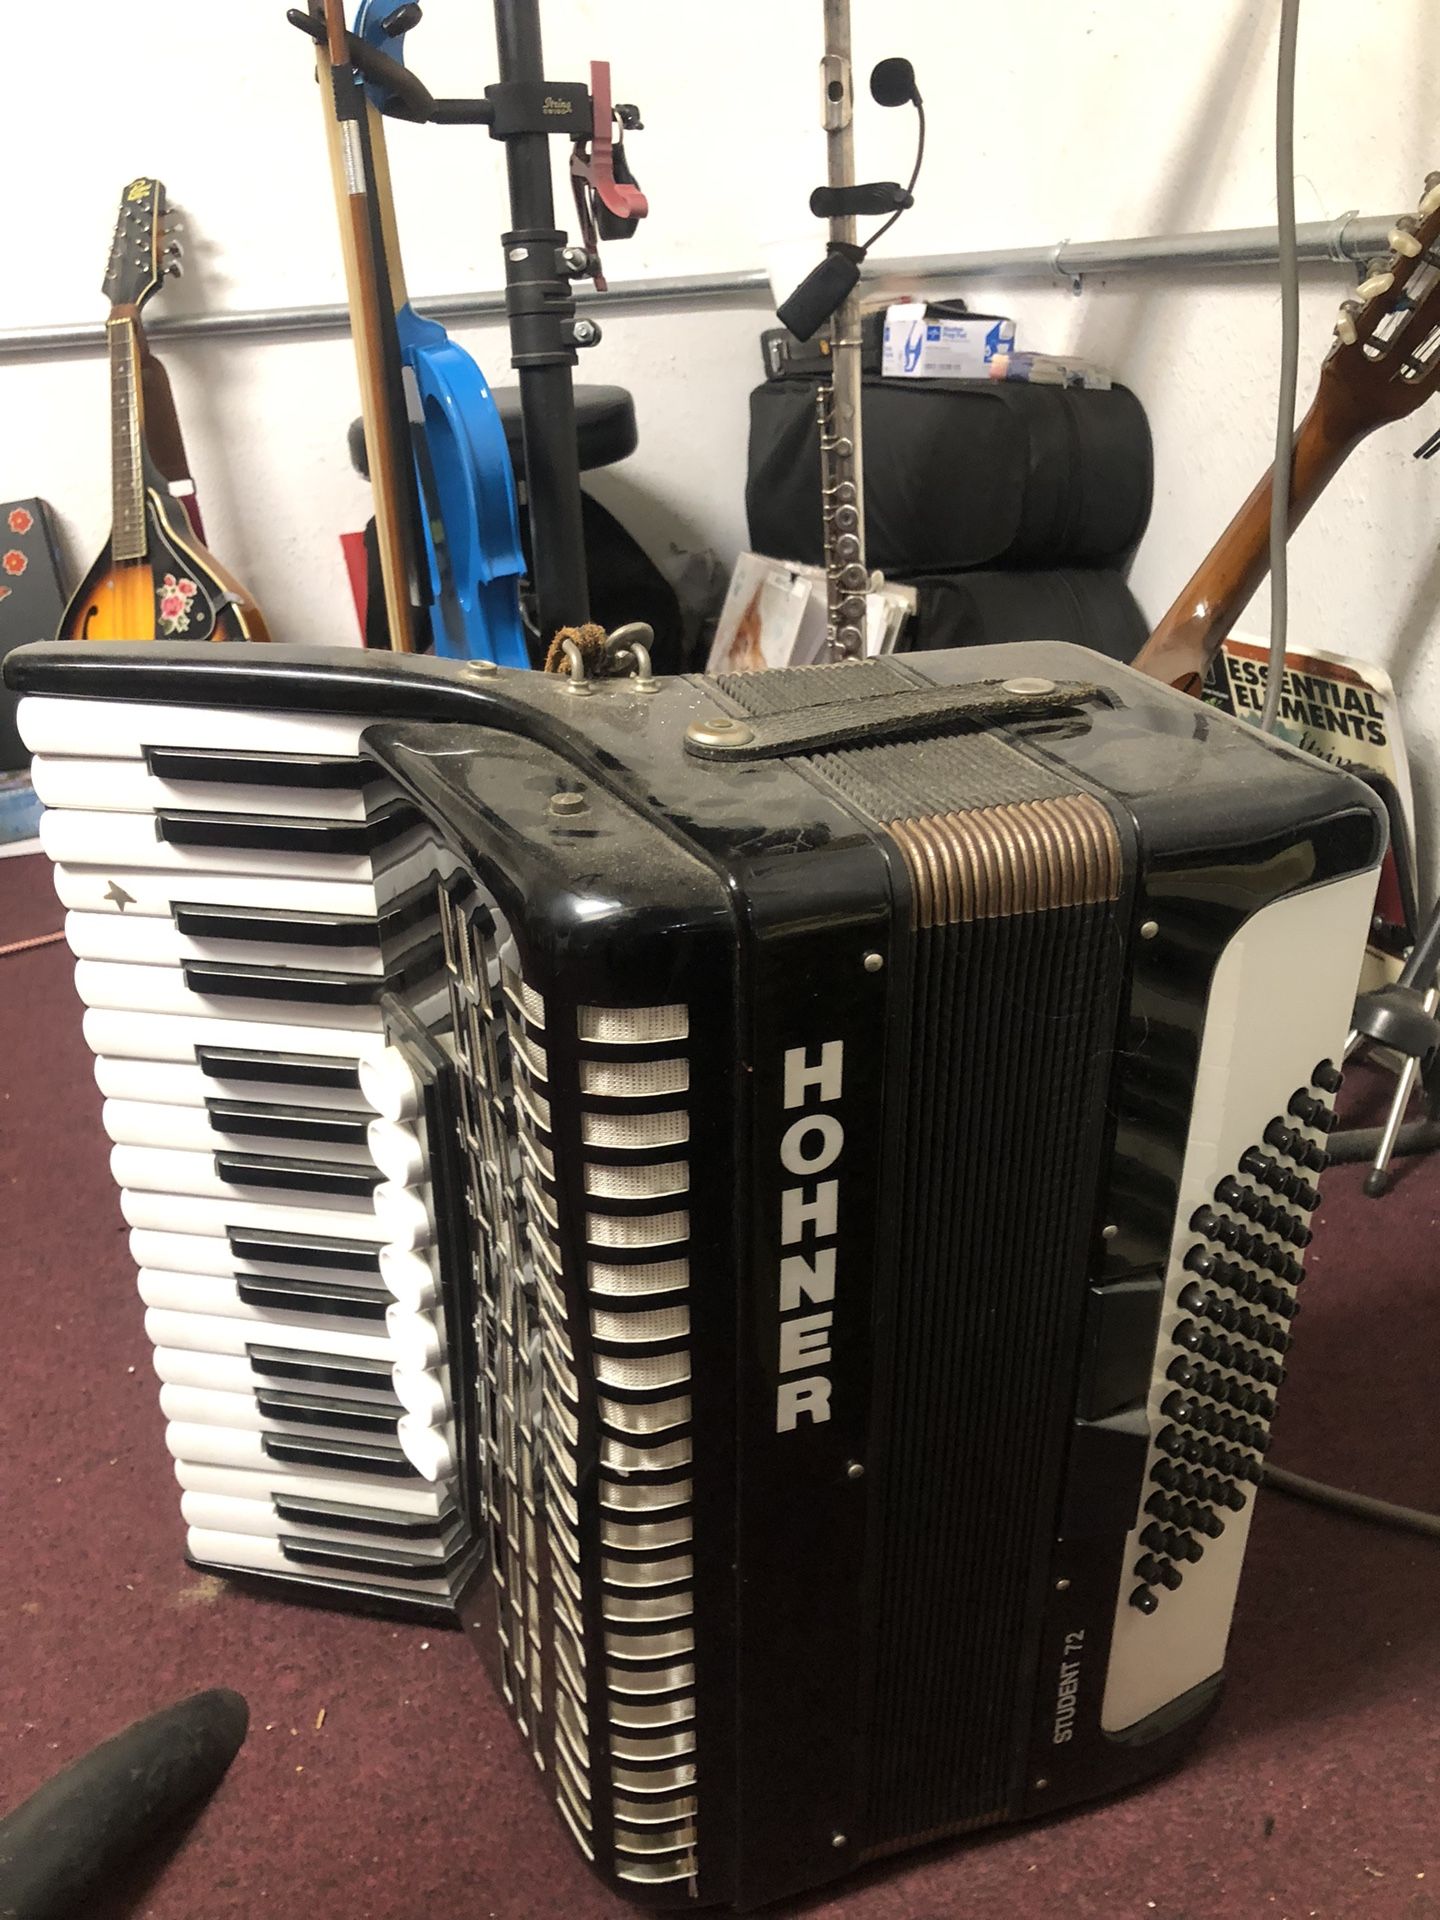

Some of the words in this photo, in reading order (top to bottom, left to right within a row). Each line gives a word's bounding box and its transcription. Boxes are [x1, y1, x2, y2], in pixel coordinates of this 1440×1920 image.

[1234, 684, 1387, 747] ELMENTS
[776, 1039, 845, 1433] HOHNER
[1064, 1629, 1085, 1656] 72
[1053, 1661, 1080, 1744] STUDENT
